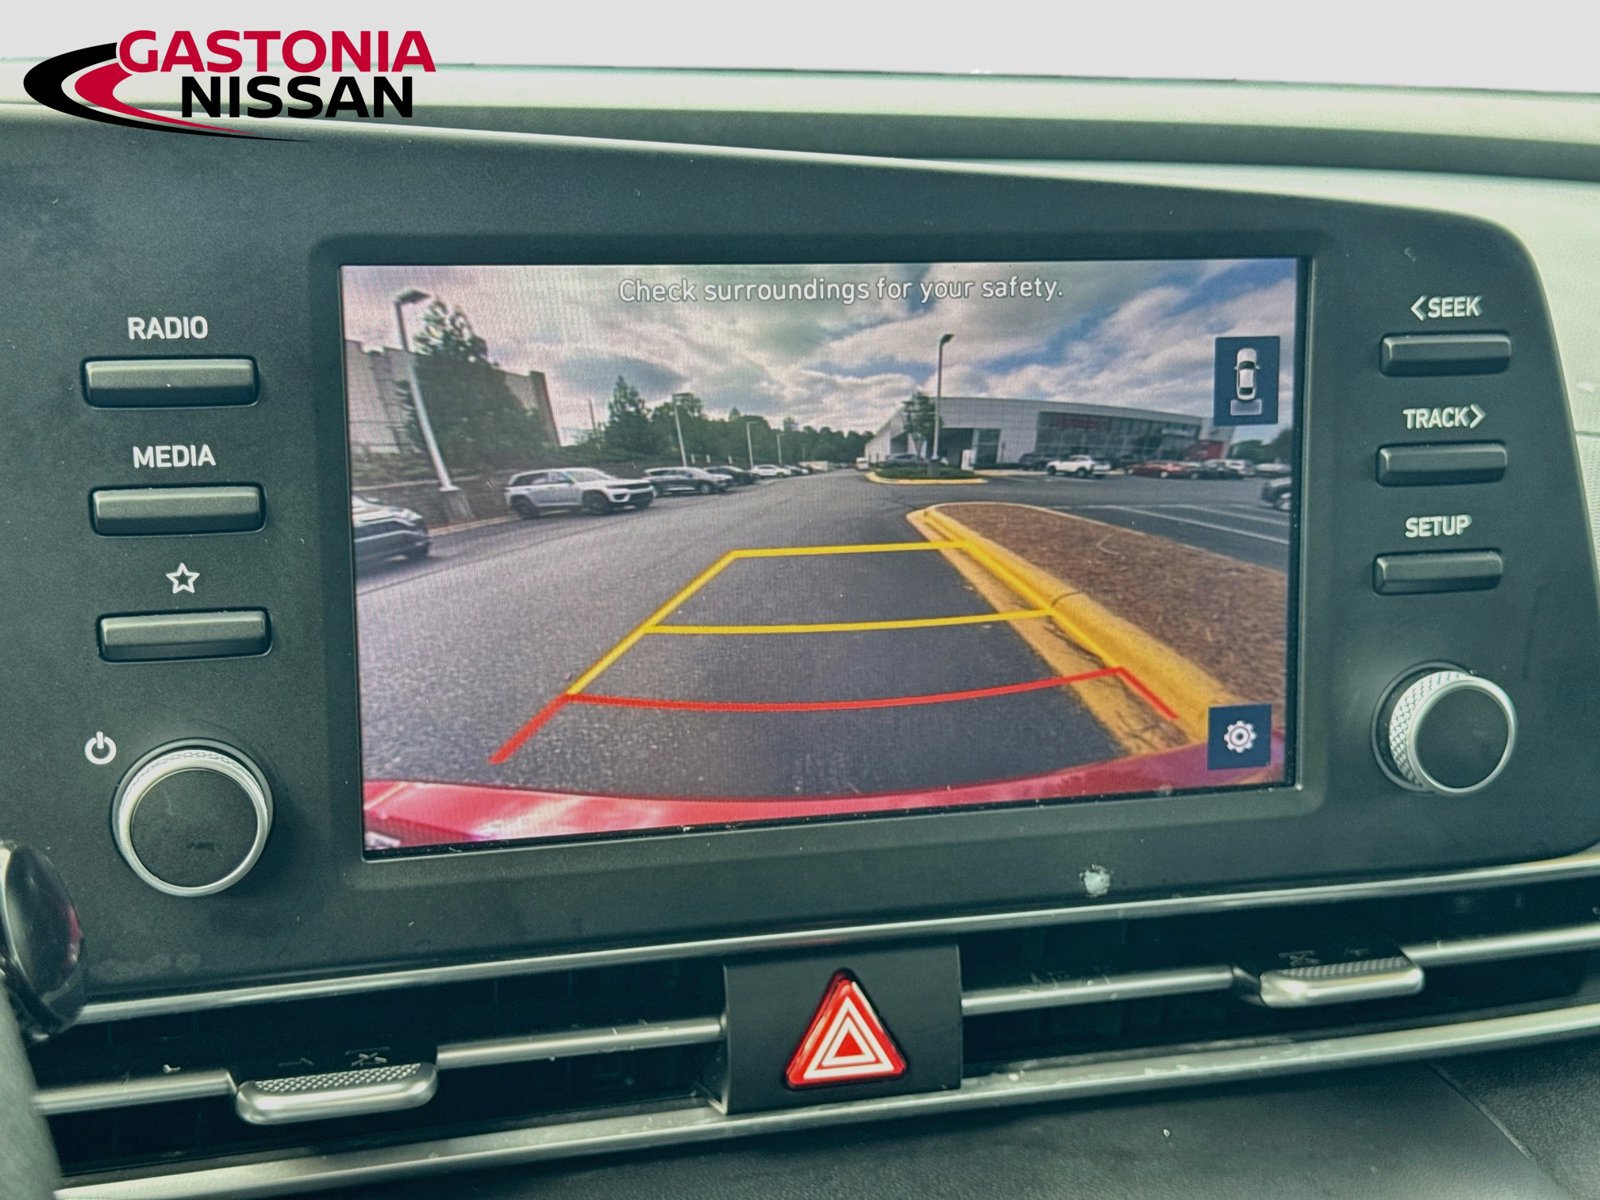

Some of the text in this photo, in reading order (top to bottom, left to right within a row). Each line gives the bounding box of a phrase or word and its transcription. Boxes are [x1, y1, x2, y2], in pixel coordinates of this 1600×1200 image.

[618, 276, 1065, 304] Check surroundings for your safety.
[1427, 296, 1481, 318] SEEK
[127, 316, 209, 340] RADIO
[1403, 407, 1470, 429] TRACK
[132, 444, 217, 469] MEDIA
[1405, 515, 1471, 538] SETUP
